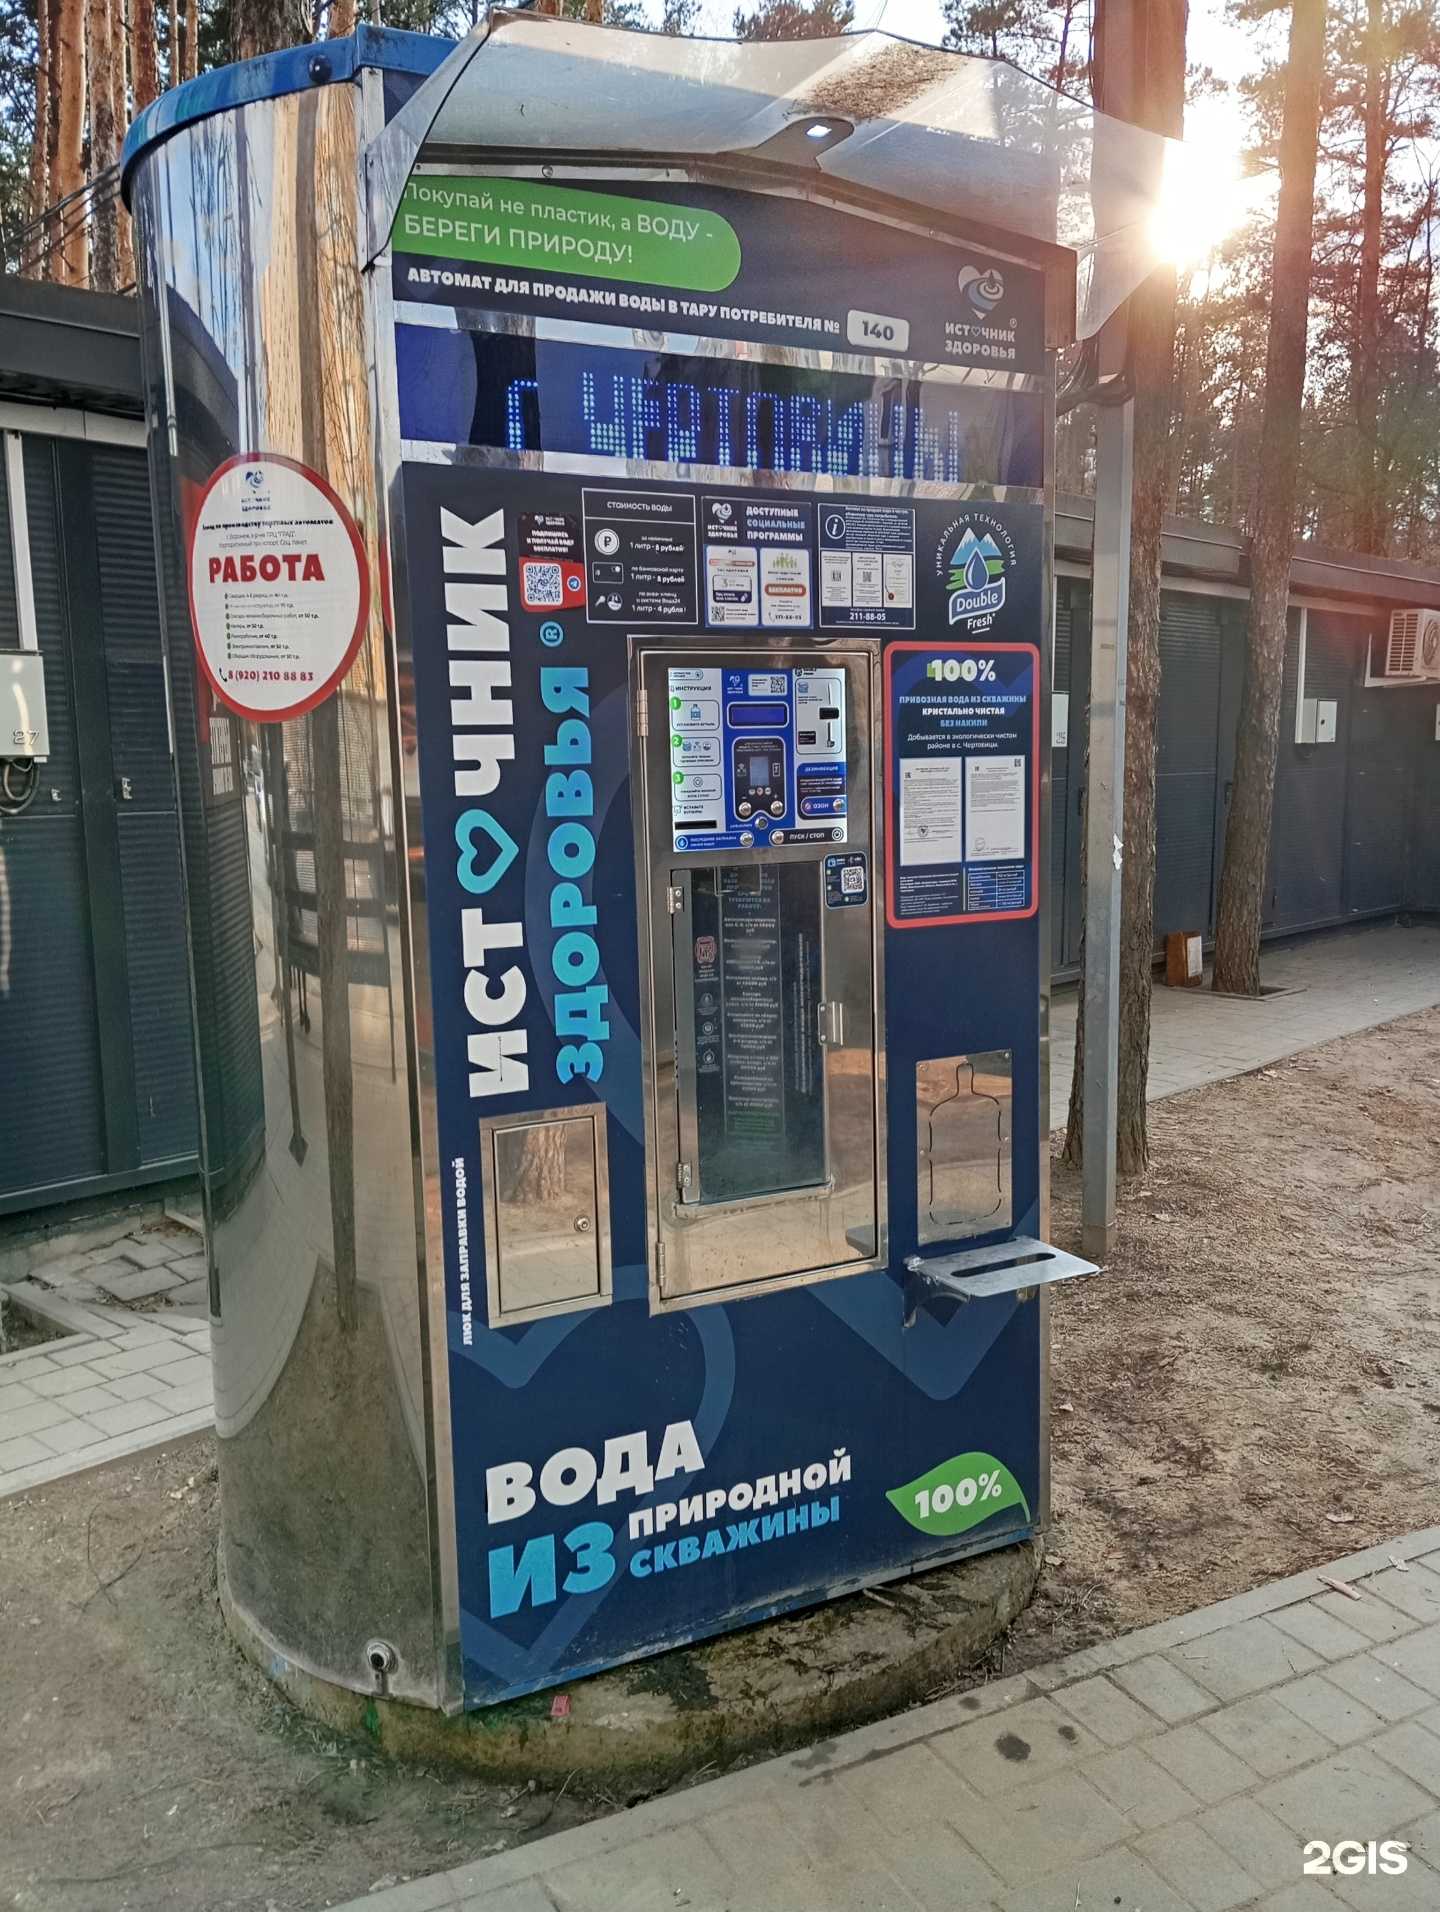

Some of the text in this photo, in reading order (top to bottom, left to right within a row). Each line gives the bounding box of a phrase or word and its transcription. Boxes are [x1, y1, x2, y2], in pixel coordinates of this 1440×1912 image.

[403, 182, 493, 210] Покупай
[500, 199, 525, 214] не
[531, 203, 616, 231] пластик,
[620, 217, 631, 231] а
[637, 213, 700, 243] ВОДУ
[404, 213, 633, 264] БЕРЕГИ ПРИРОДУ!
[407, 267, 840, 334] АВТОМАТ ДЛЯ ПРОДАЖИ ВОДЫ В ТАРУ ПОТРЕБИТЕЛЯ №
[861, 319, 894, 341] 140
[944, 340, 1016, 359] ЗДОРОВЬЯ
[607, 501, 673, 513] СТОИМОСТЬ ВОДЫ
[746, 505, 799, 517] ДОСТУПНЫЕ
[746, 518, 805, 529] СОЦИАЛЬНЫЕ
[746, 530, 803, 542] ПРОГРАММЫ
[935, 513, 970, 577] УНИКАЛЬНАЯ
[973, 512, 1017, 567] ТЕХНОЛОГИЯ
[209, 553, 326, 584] РАБОТА
[956, 590, 999, 612] Double
[849, 612, 886, 621] 211-88-05
[228, 670, 234, 680] 8
[235, 670, 260, 682] (920)
[262, 671, 280, 681] 210
[930, 659, 997, 682] 100%
[899, 695, 1027, 704] ПРИВОЗНАЯ ВОДА ИЗ СКВАЖИНЫ
[922, 706, 1005, 716] КРИСТАЛЬНО ЧИСТАЯ
[940, 719, 955, 728] БЕЗ
[12, 728, 40, 746] 27
[539, 665, 610, 1086] ЗДОРОВЬЯ
[451, 1156, 474, 1346] ЛЮК ДЛЯ ЗАПРАВКИ ВОДОЙ
[484, 1418, 706, 1525] ВОДА
[627, 1446, 852, 1540] ПРИРОДНОЙ
[913, 1468, 1003, 1519] 100%
[629, 1495, 841, 1579] СКВАЖИНЫ
[487, 1520, 617, 1620] ИЗ
